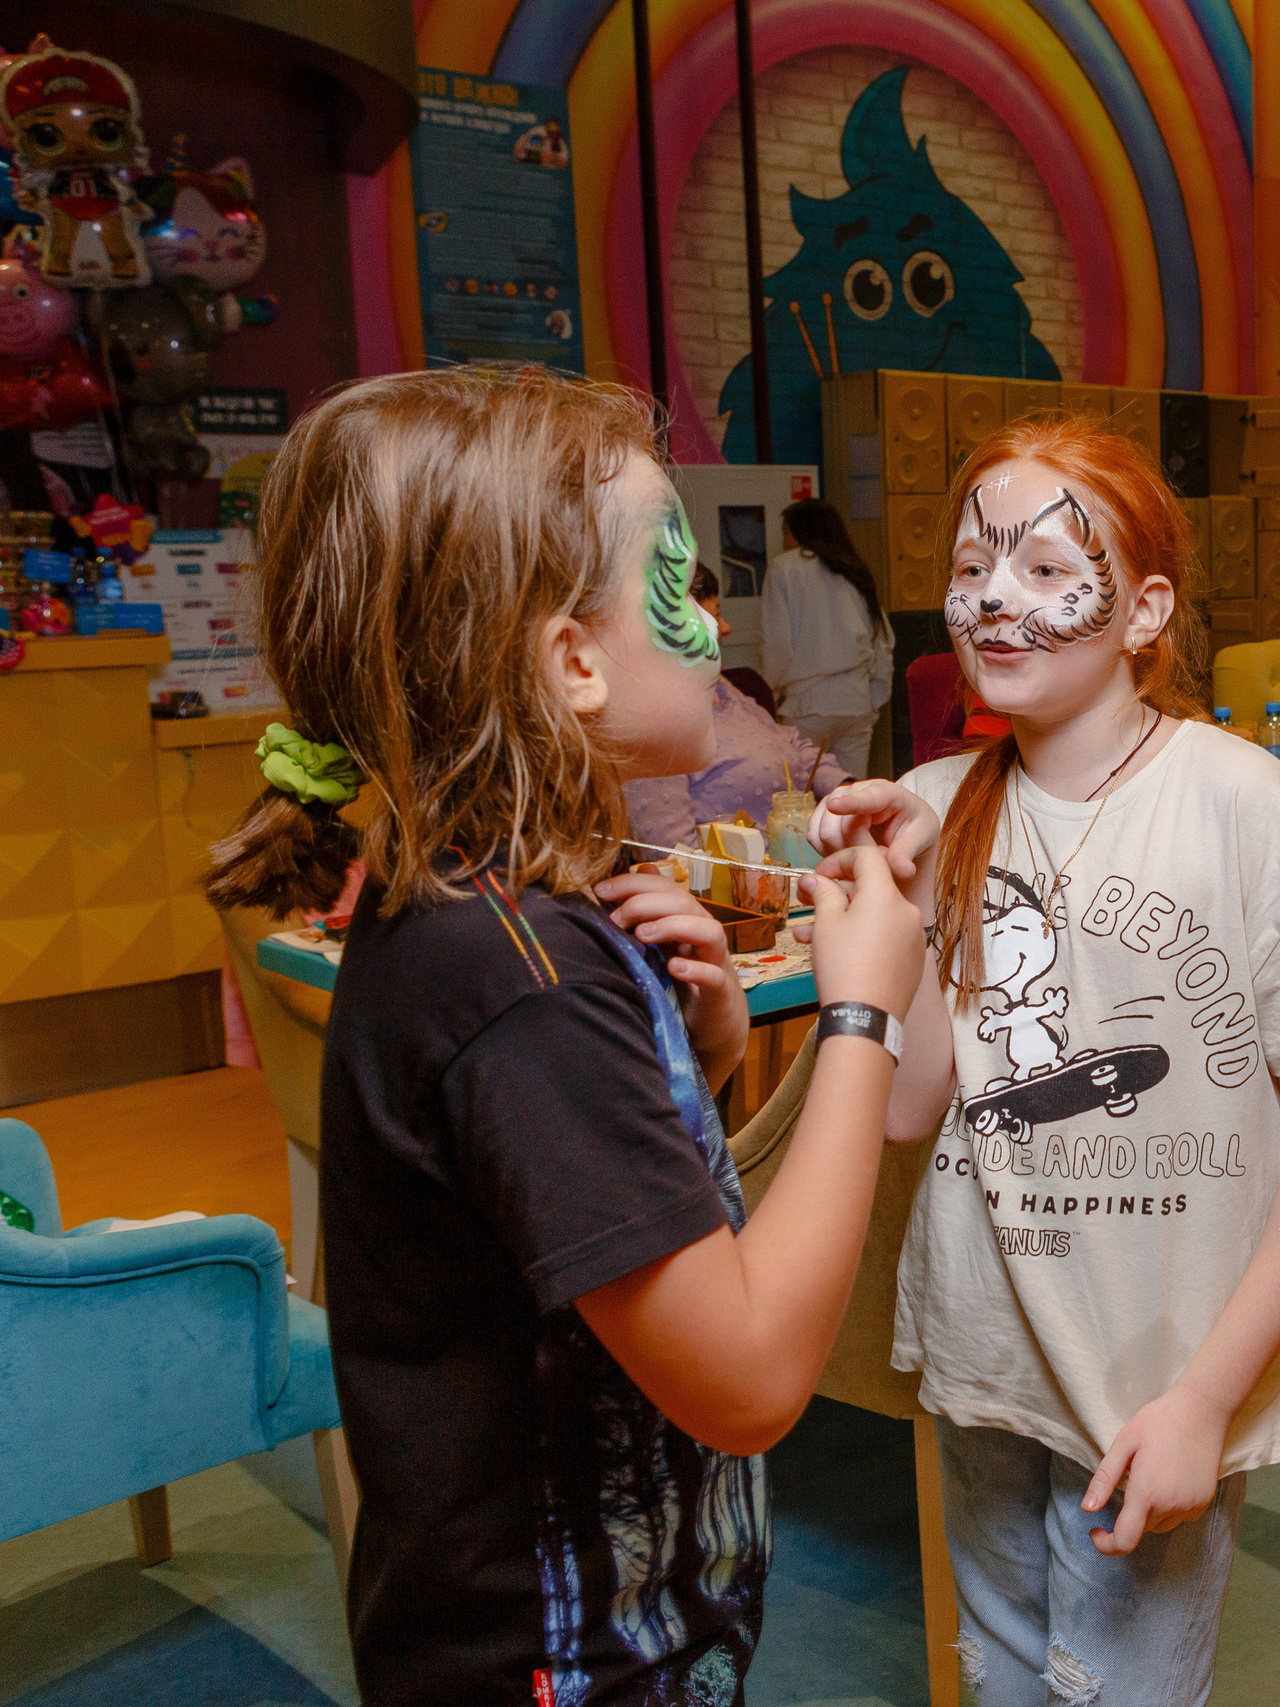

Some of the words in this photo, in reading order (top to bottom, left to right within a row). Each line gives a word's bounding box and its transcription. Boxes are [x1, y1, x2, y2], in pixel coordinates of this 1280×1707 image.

[1081, 875, 1260, 1089] BEYOND
[1042, 1134, 1137, 1180] AND
[1145, 1131, 1247, 1179] ROLL
[1020, 1193, 1188, 1216] HAPPINESS
